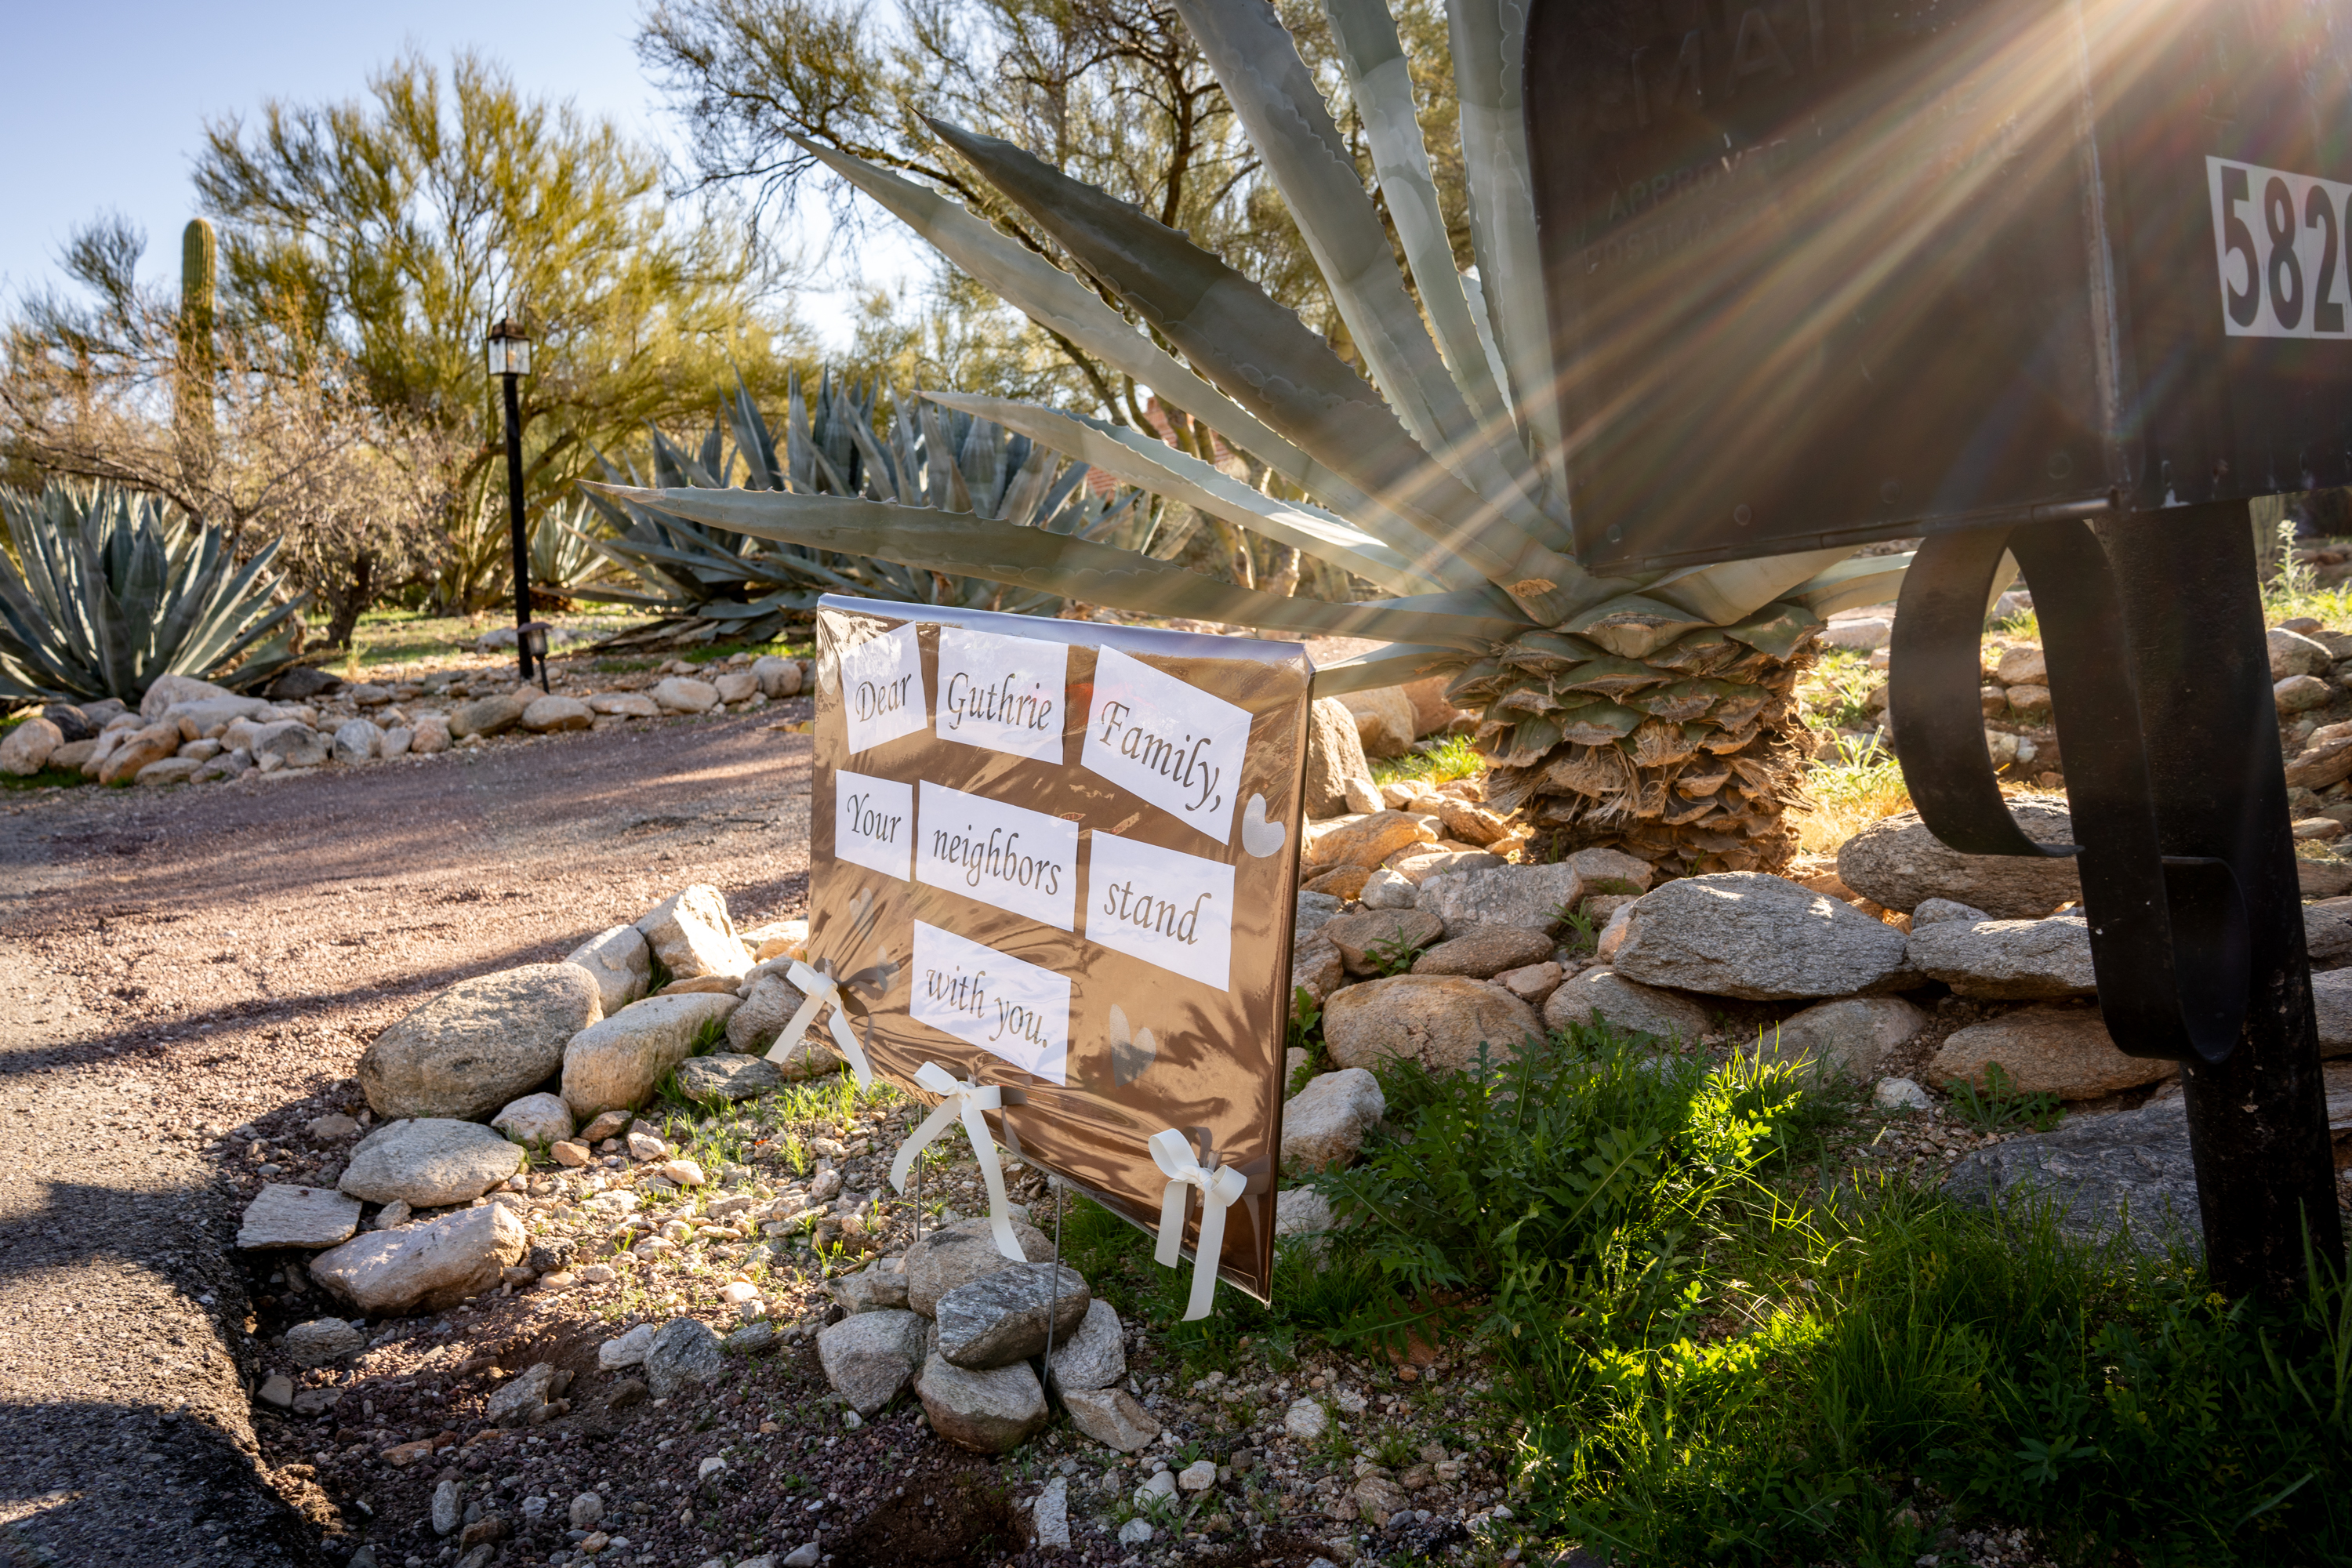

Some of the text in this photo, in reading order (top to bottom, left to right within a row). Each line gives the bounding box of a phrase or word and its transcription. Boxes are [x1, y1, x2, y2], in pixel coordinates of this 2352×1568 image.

[2221, 165, 2352, 330] 582
[855, 672, 1223, 813] Dear Guthrie Family,
[847, 793, 1213, 946] Your neighbors stand
[926, 965, 1049, 1049] with you.
